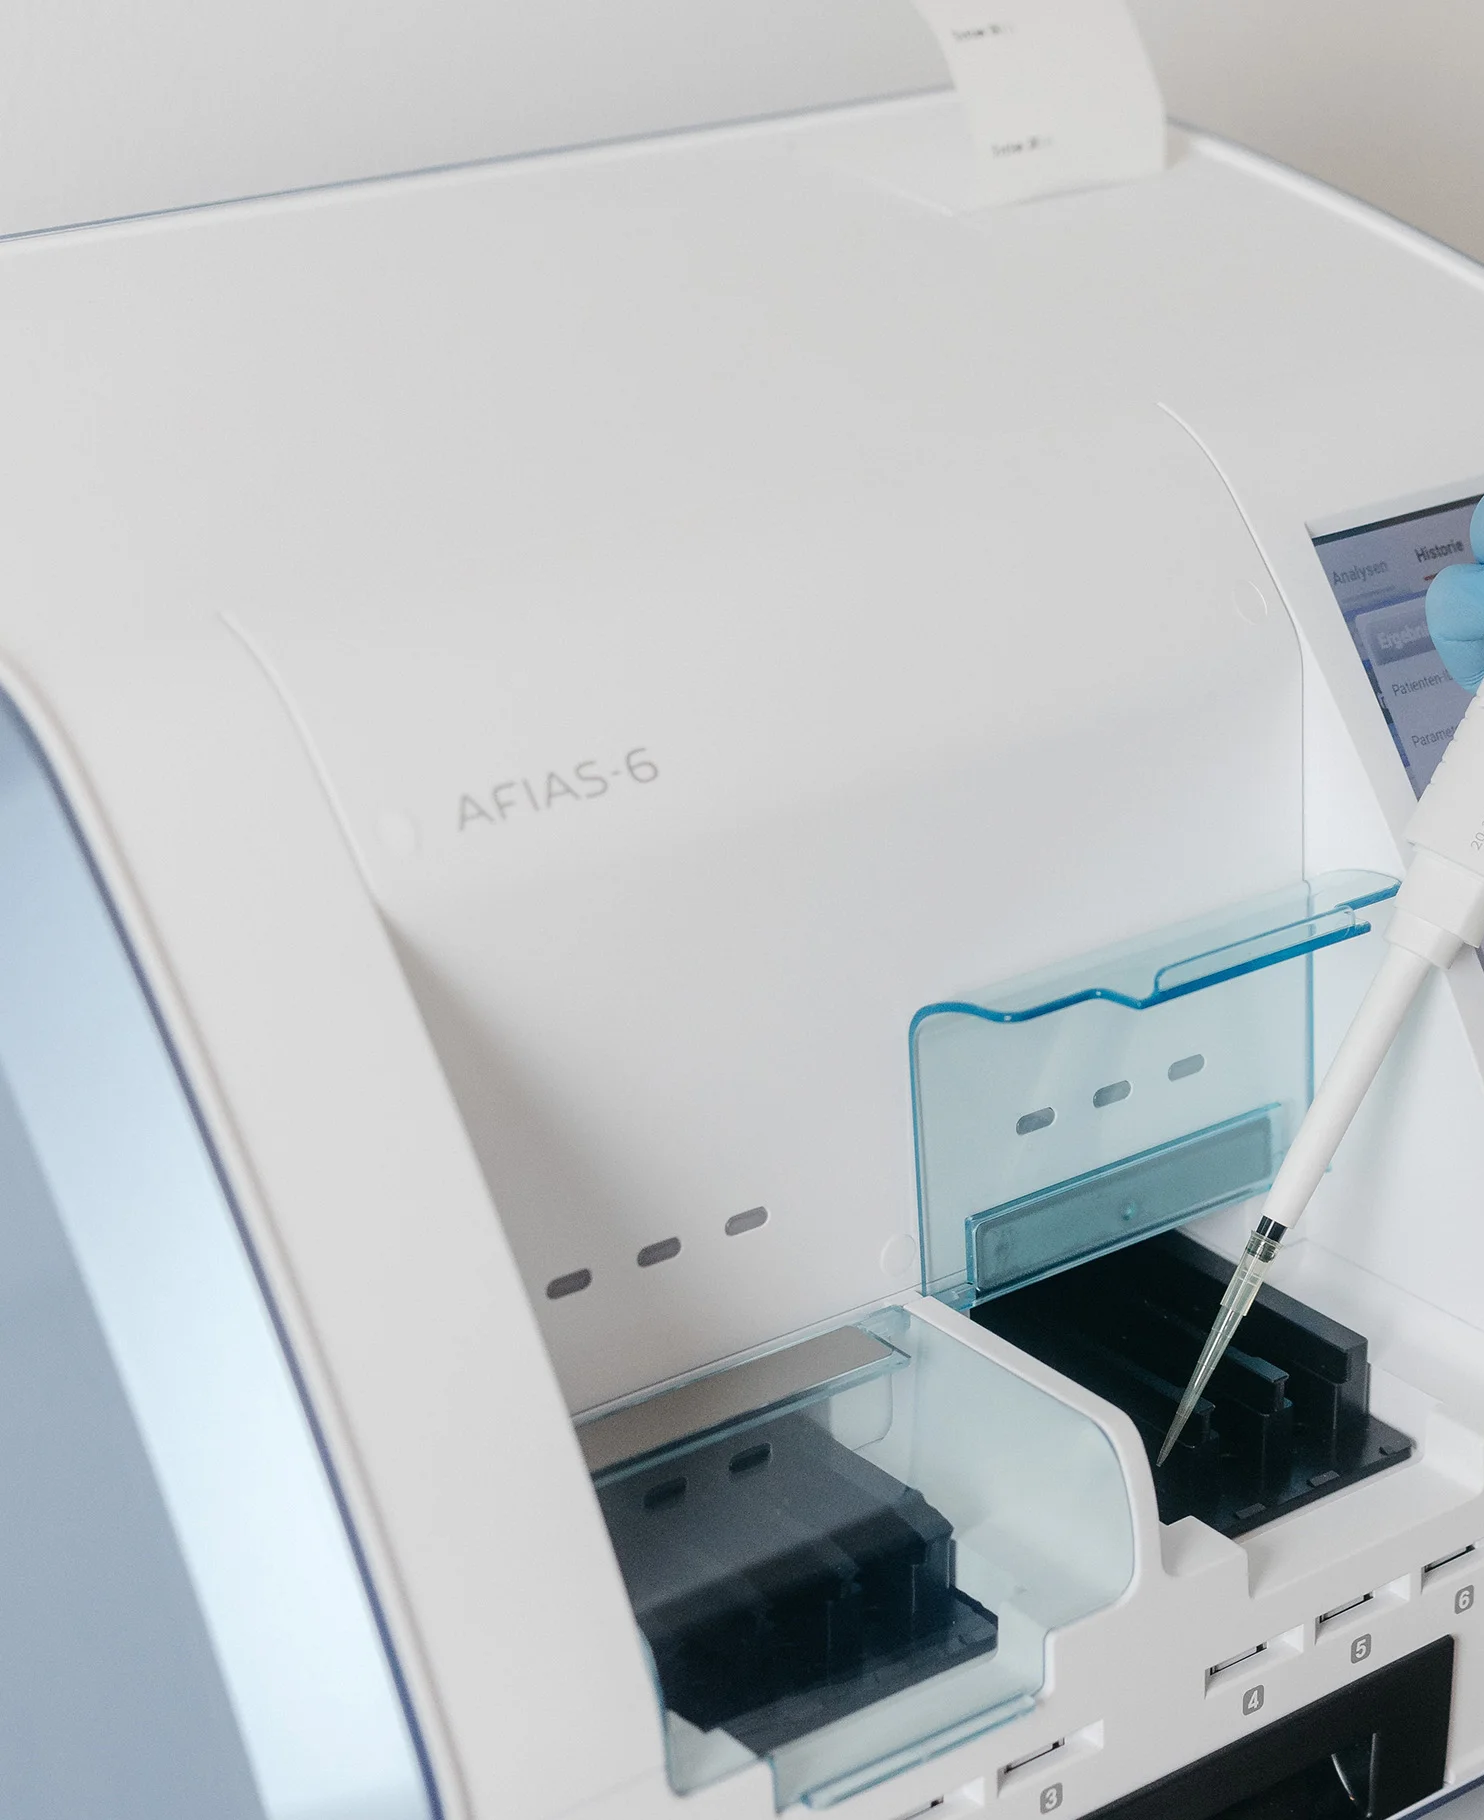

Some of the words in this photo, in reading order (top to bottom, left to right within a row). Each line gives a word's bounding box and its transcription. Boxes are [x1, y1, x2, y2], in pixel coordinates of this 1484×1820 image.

[1331, 559, 1389, 587] Analysen
[1413, 538, 1465, 563] Historie
[457, 747, 659, 831] AFIAS-6
